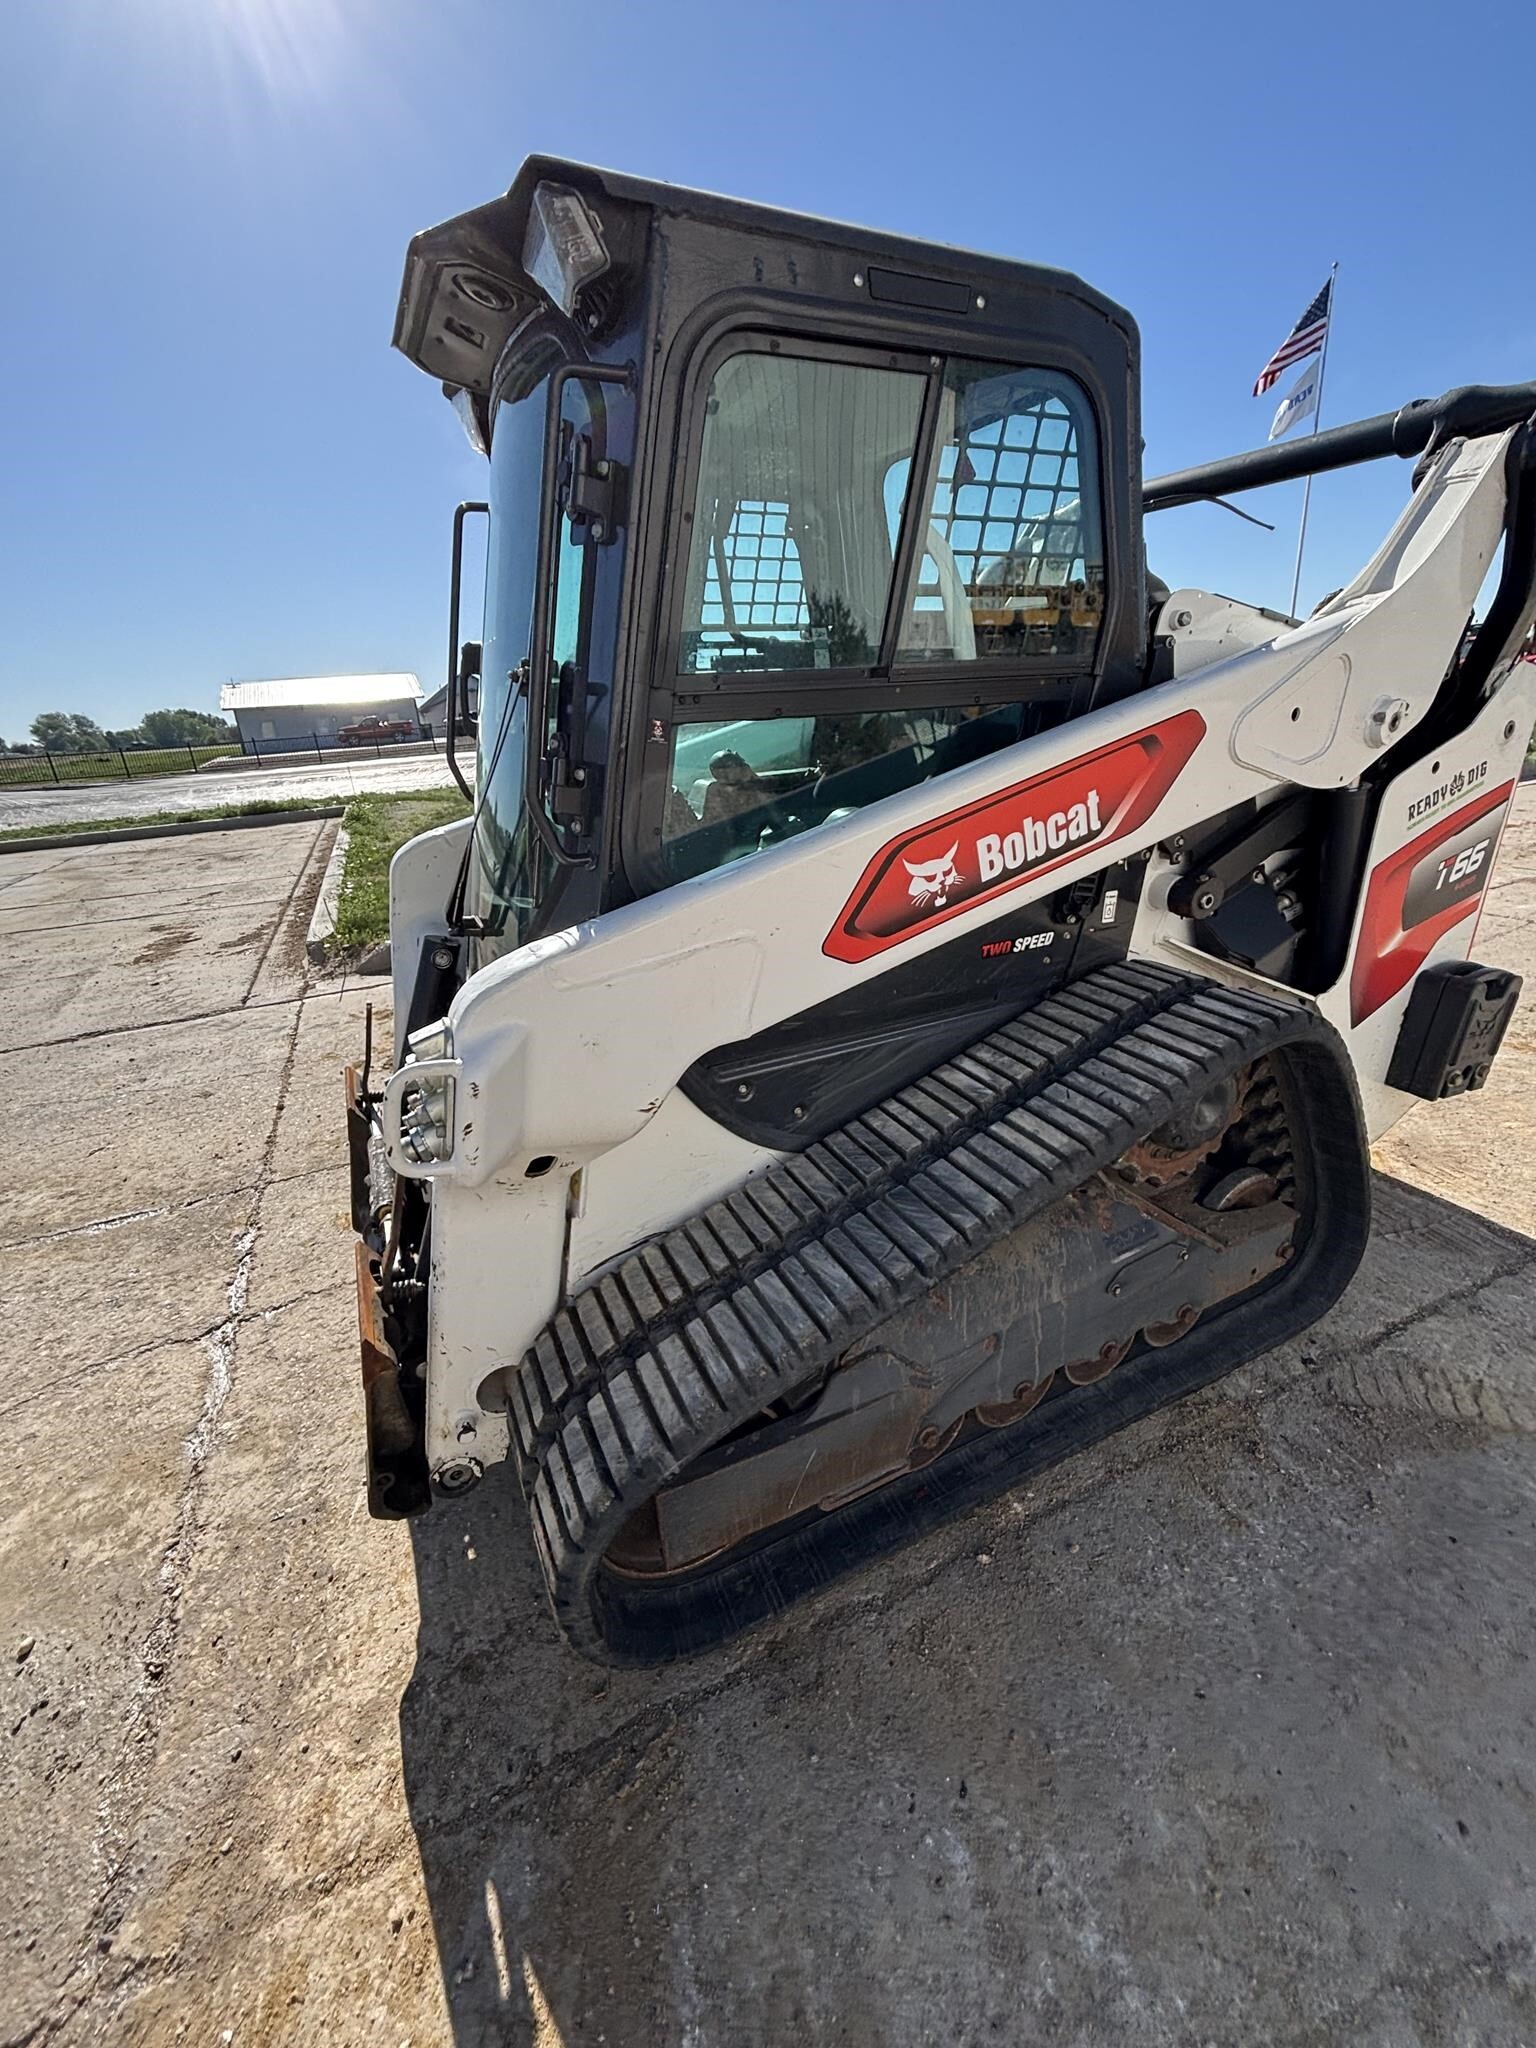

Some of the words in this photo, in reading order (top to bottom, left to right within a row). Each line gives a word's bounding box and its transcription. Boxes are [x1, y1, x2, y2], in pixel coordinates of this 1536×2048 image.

[1408, 784, 1448, 821] READY
[1467, 761, 1487, 785] DIG
[976, 789, 1101, 883] Bobcat
[1435, 838, 1490, 891] T66
[982, 940, 1012, 958] TWO
[1013, 931, 1054, 953] SPEED
